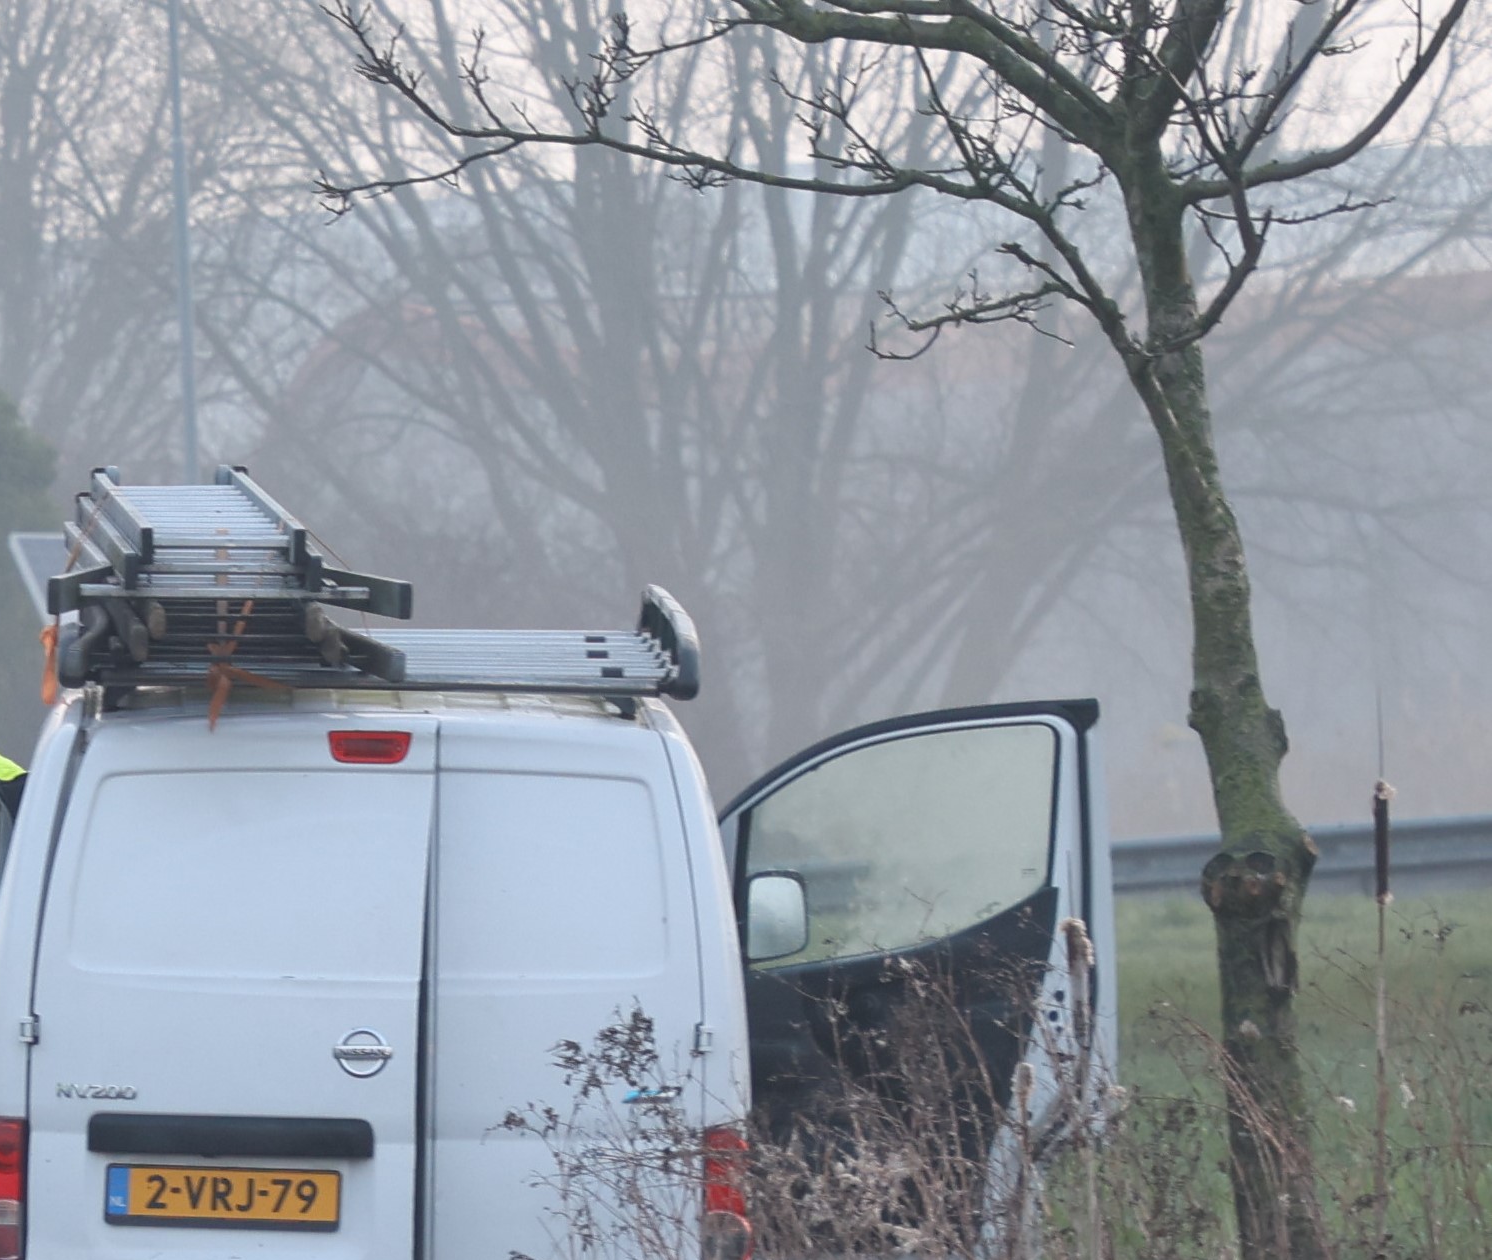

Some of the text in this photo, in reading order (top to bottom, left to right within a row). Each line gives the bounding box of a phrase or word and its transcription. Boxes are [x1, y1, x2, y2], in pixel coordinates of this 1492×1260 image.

[56, 1083, 138, 1100] NV200
[109, 1195, 127, 1207] NL
[145, 1174, 318, 1214] 2-VRJ-79
